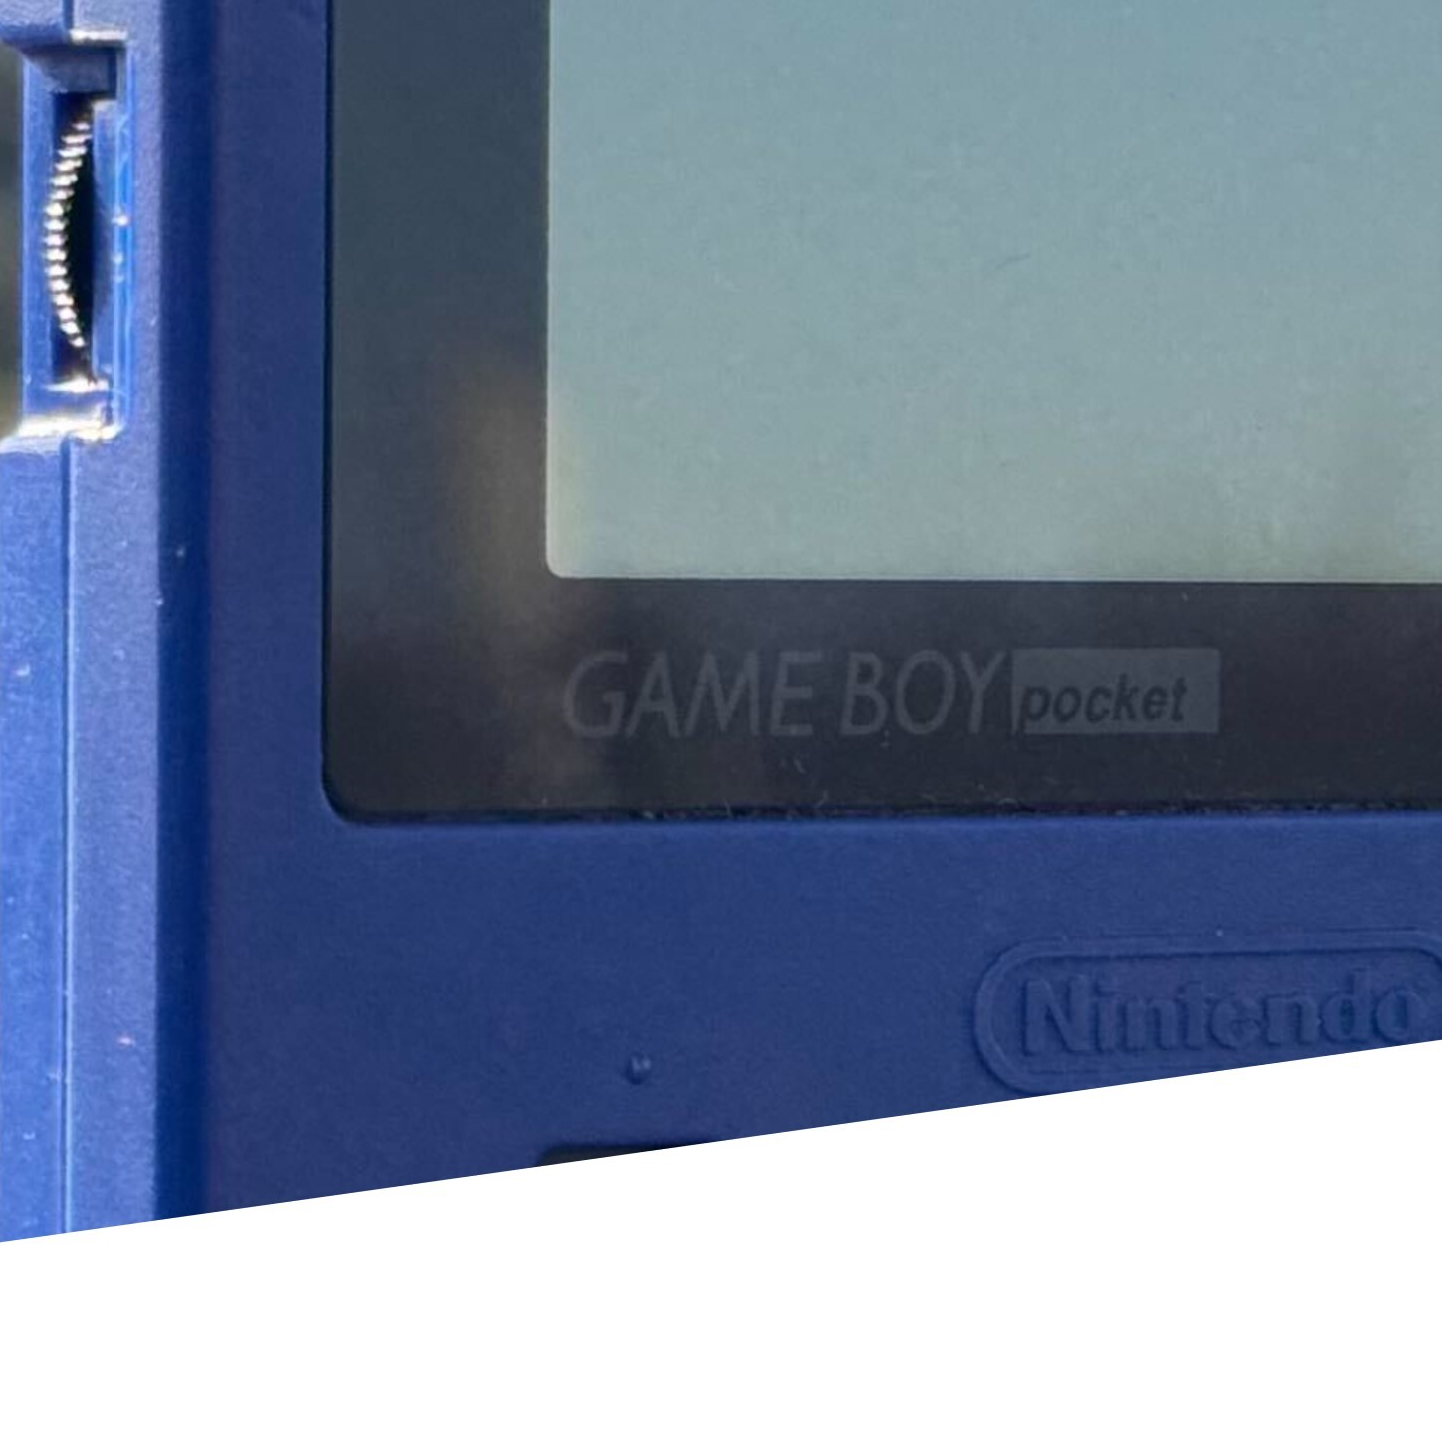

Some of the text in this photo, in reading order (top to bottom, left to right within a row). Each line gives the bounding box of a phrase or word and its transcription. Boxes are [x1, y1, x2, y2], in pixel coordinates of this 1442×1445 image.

[561, 651, 1188, 739] GAME BOY pocket
[1021, 967, 1425, 1056] Nintendo
